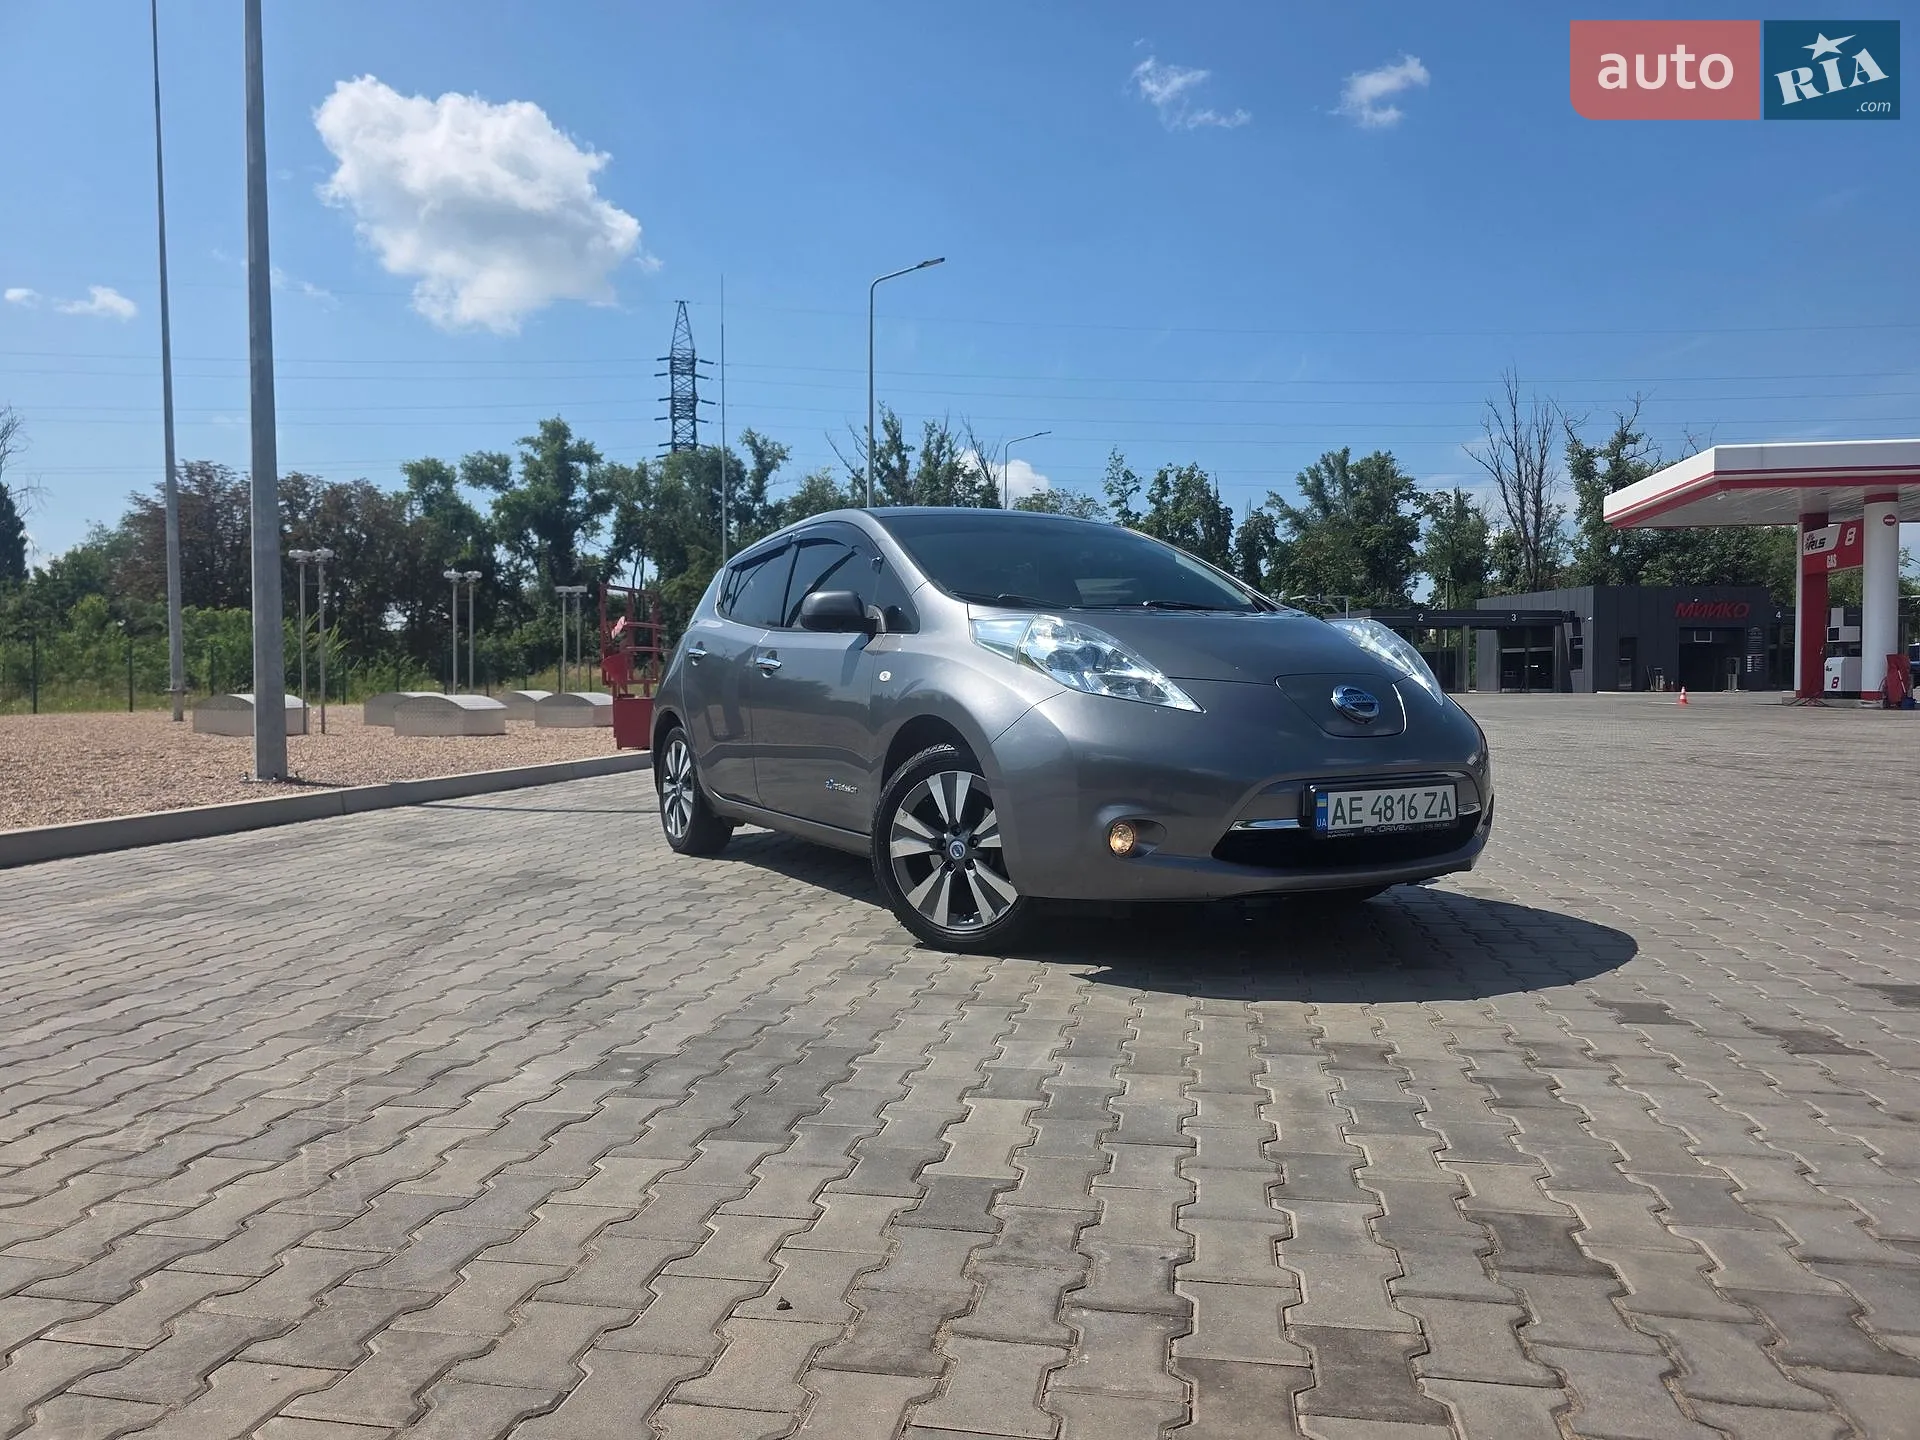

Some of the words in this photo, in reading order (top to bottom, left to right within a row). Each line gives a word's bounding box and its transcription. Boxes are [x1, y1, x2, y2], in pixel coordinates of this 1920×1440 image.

[1845, 527, 1857, 546] 8
[1417, 613, 1424, 621] 2
[1511, 613, 1517, 622] 3
[1831, 676, 1840, 690] 8
[1331, 796, 1364, 826] AE
[1370, 793, 1419, 823] 4816
[1424, 791, 1453, 819] ZA
[1316, 818, 1327, 827] UA
